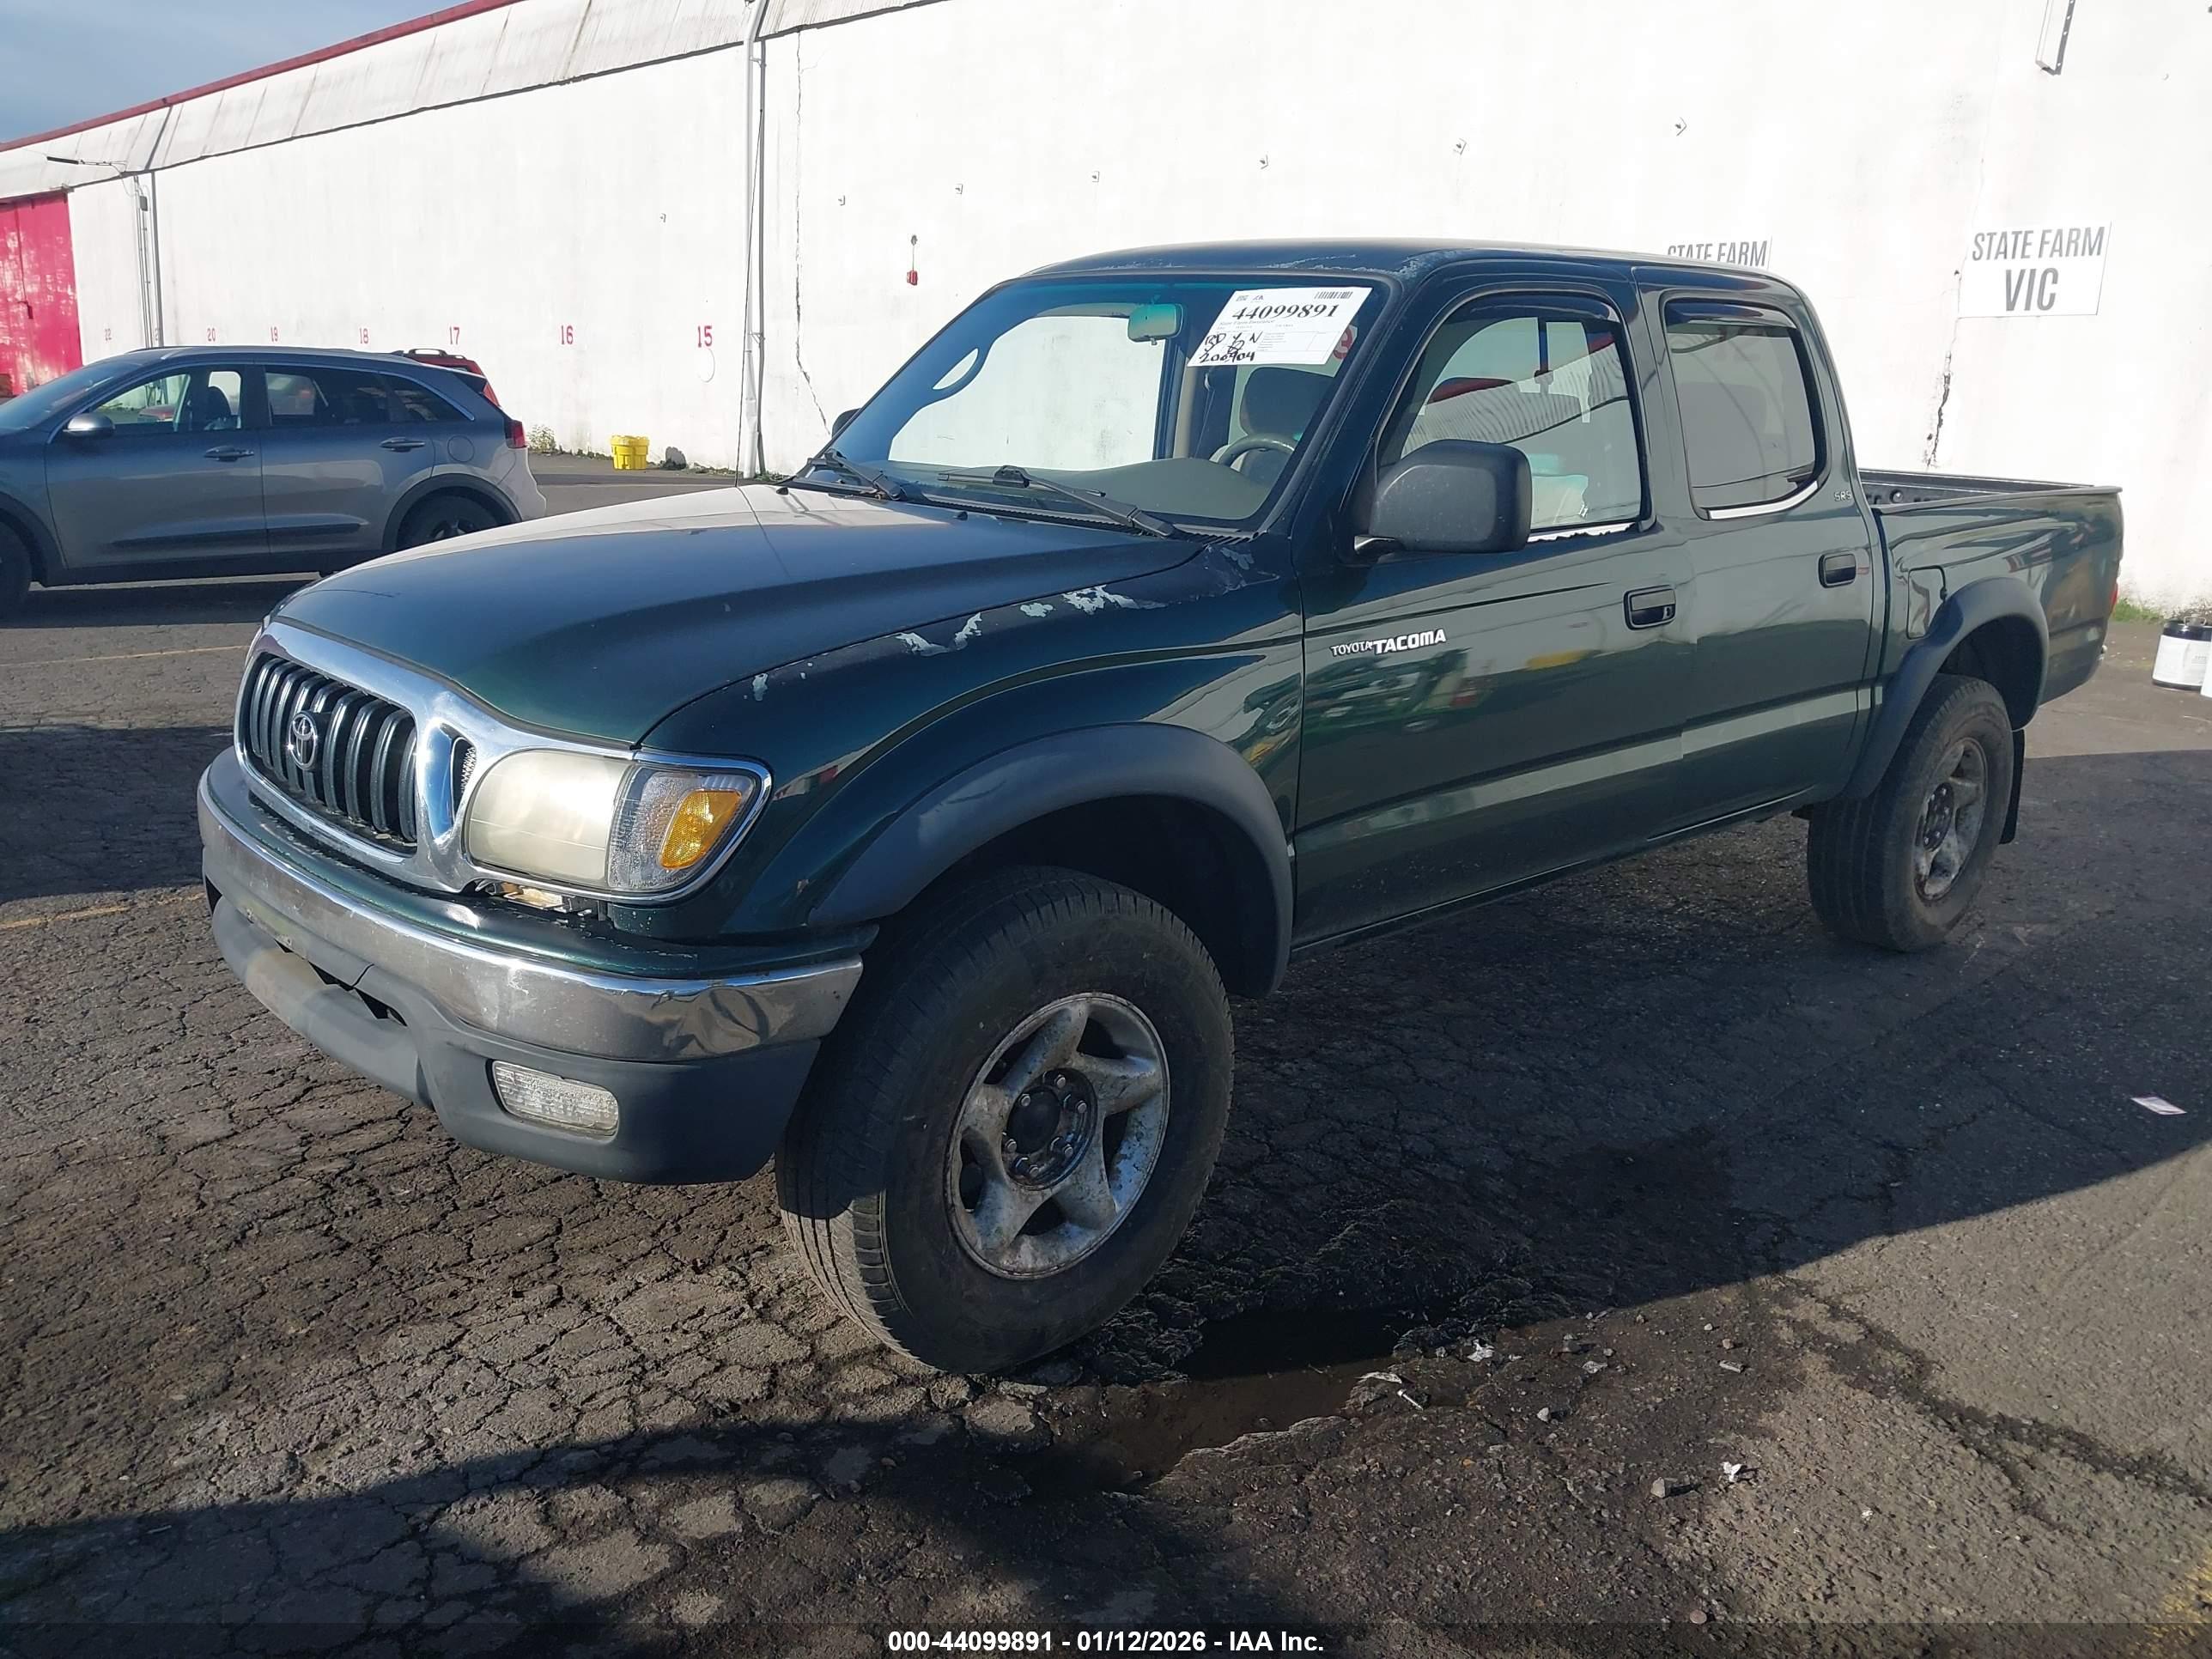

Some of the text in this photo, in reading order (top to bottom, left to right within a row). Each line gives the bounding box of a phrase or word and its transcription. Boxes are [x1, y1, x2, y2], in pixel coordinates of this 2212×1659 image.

[1717, 240, 1767, 266] FARM
[1972, 226, 2105, 261] STATE FARM
[2005, 267, 2059, 312] VIC
[1231, 304, 1340, 320] 44099891
[207, 328, 216, 342] 20
[270, 326, 279, 342] 19
[359, 327, 369, 344] 18
[449, 326, 460, 344] 17
[561, 325, 574, 345] 16
[697, 325, 713, 348] 15
[1331, 629, 1446, 656] TOYOTA TACOMA
